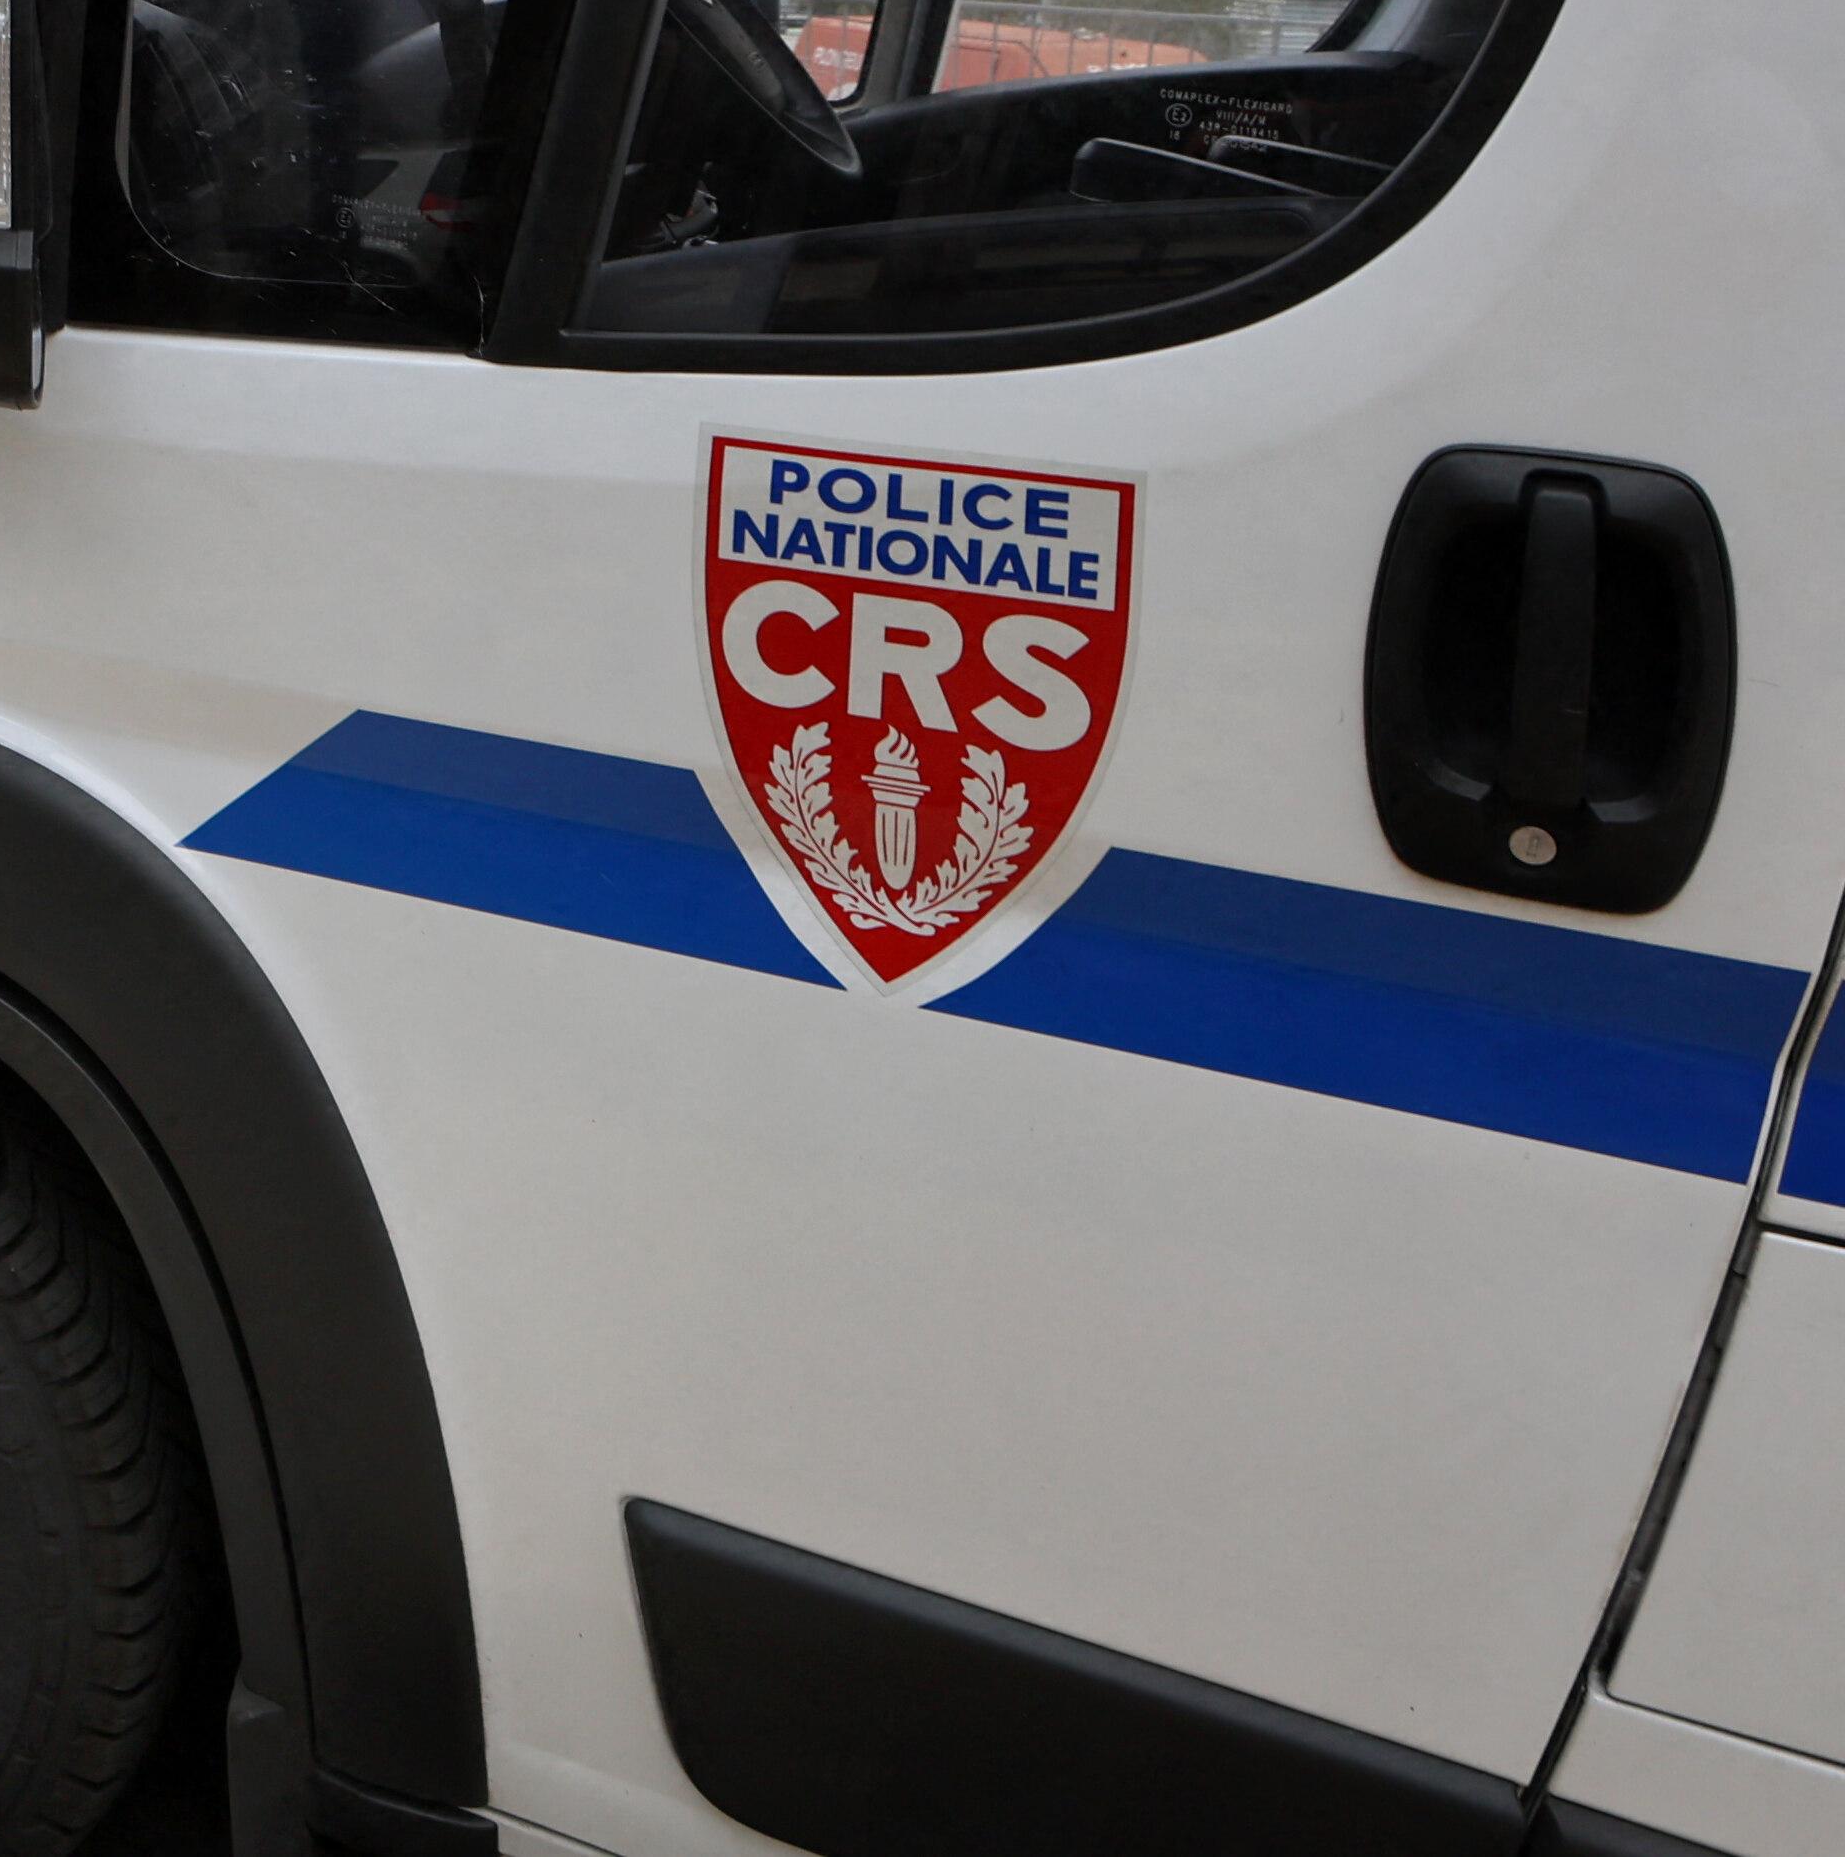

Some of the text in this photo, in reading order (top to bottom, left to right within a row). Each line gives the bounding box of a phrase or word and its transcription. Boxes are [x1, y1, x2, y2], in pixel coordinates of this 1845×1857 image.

[768, 458, 1070, 540] POLICE
[731, 508, 1099, 601] NATIONALE
[721, 580, 1092, 752] CRS
